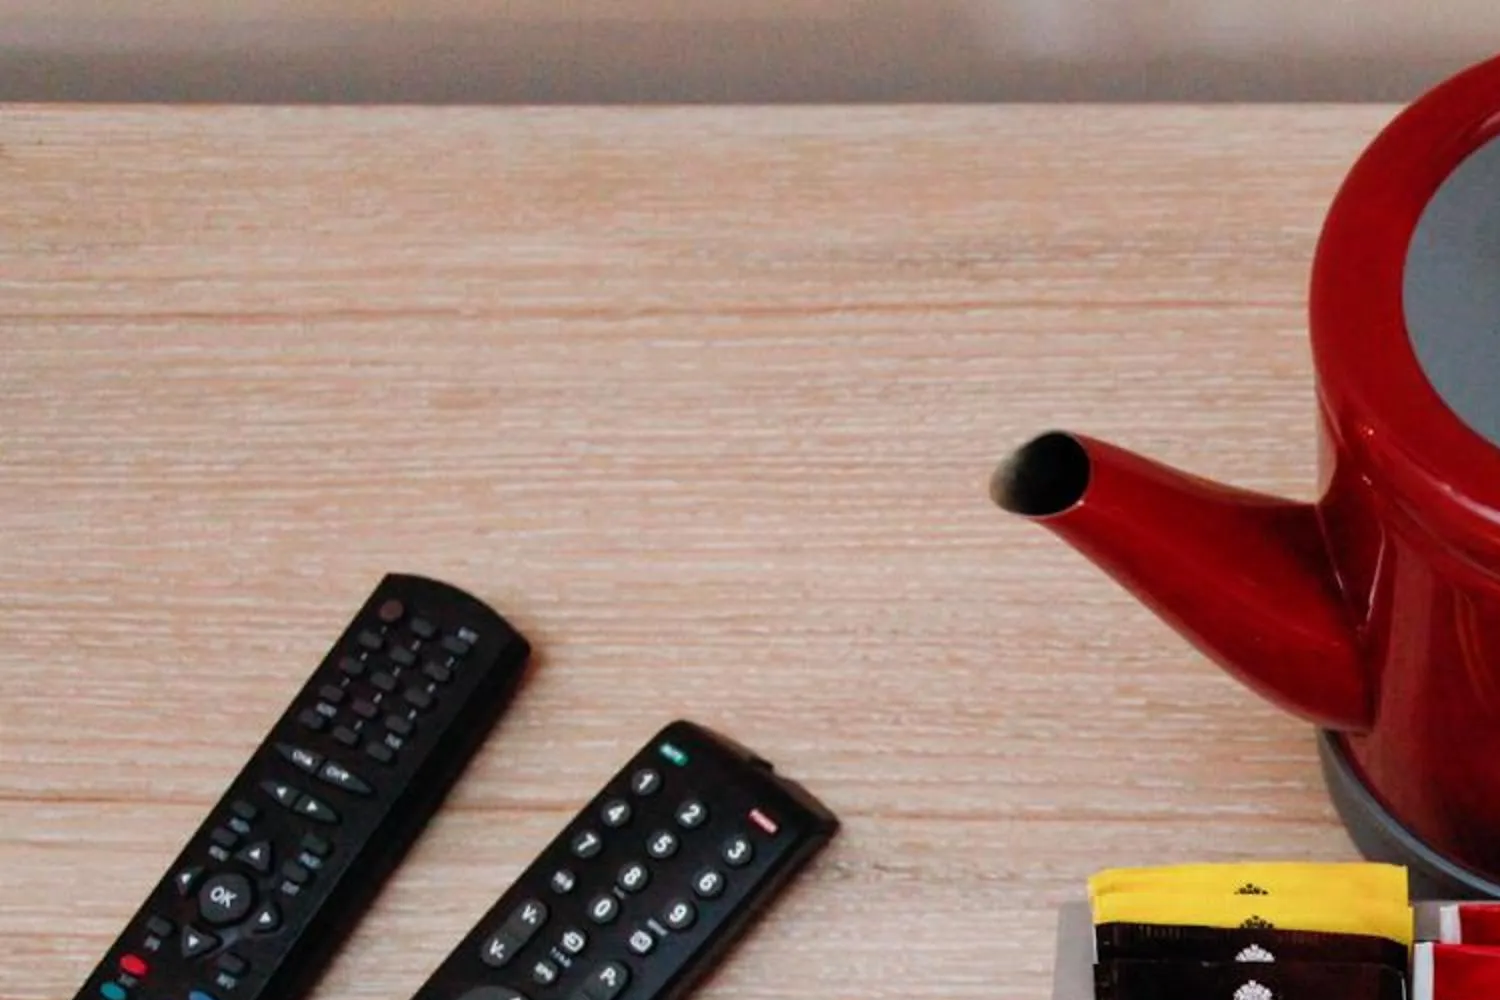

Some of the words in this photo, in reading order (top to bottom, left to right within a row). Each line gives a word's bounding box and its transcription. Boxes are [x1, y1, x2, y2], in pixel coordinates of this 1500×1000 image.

[639, 774, 653, 791] 1
[607, 804, 625, 822] 4
[681, 805, 700, 824] 2
[577, 834, 597, 852] 7
[653, 834, 672, 853] 5
[728, 840, 746, 860] 3
[623, 867, 641, 886] 8
[699, 872, 717, 891] 6
[210, 886, 237, 909] OK
[594, 899, 611, 917] 0
[670, 904, 687, 923] 9
